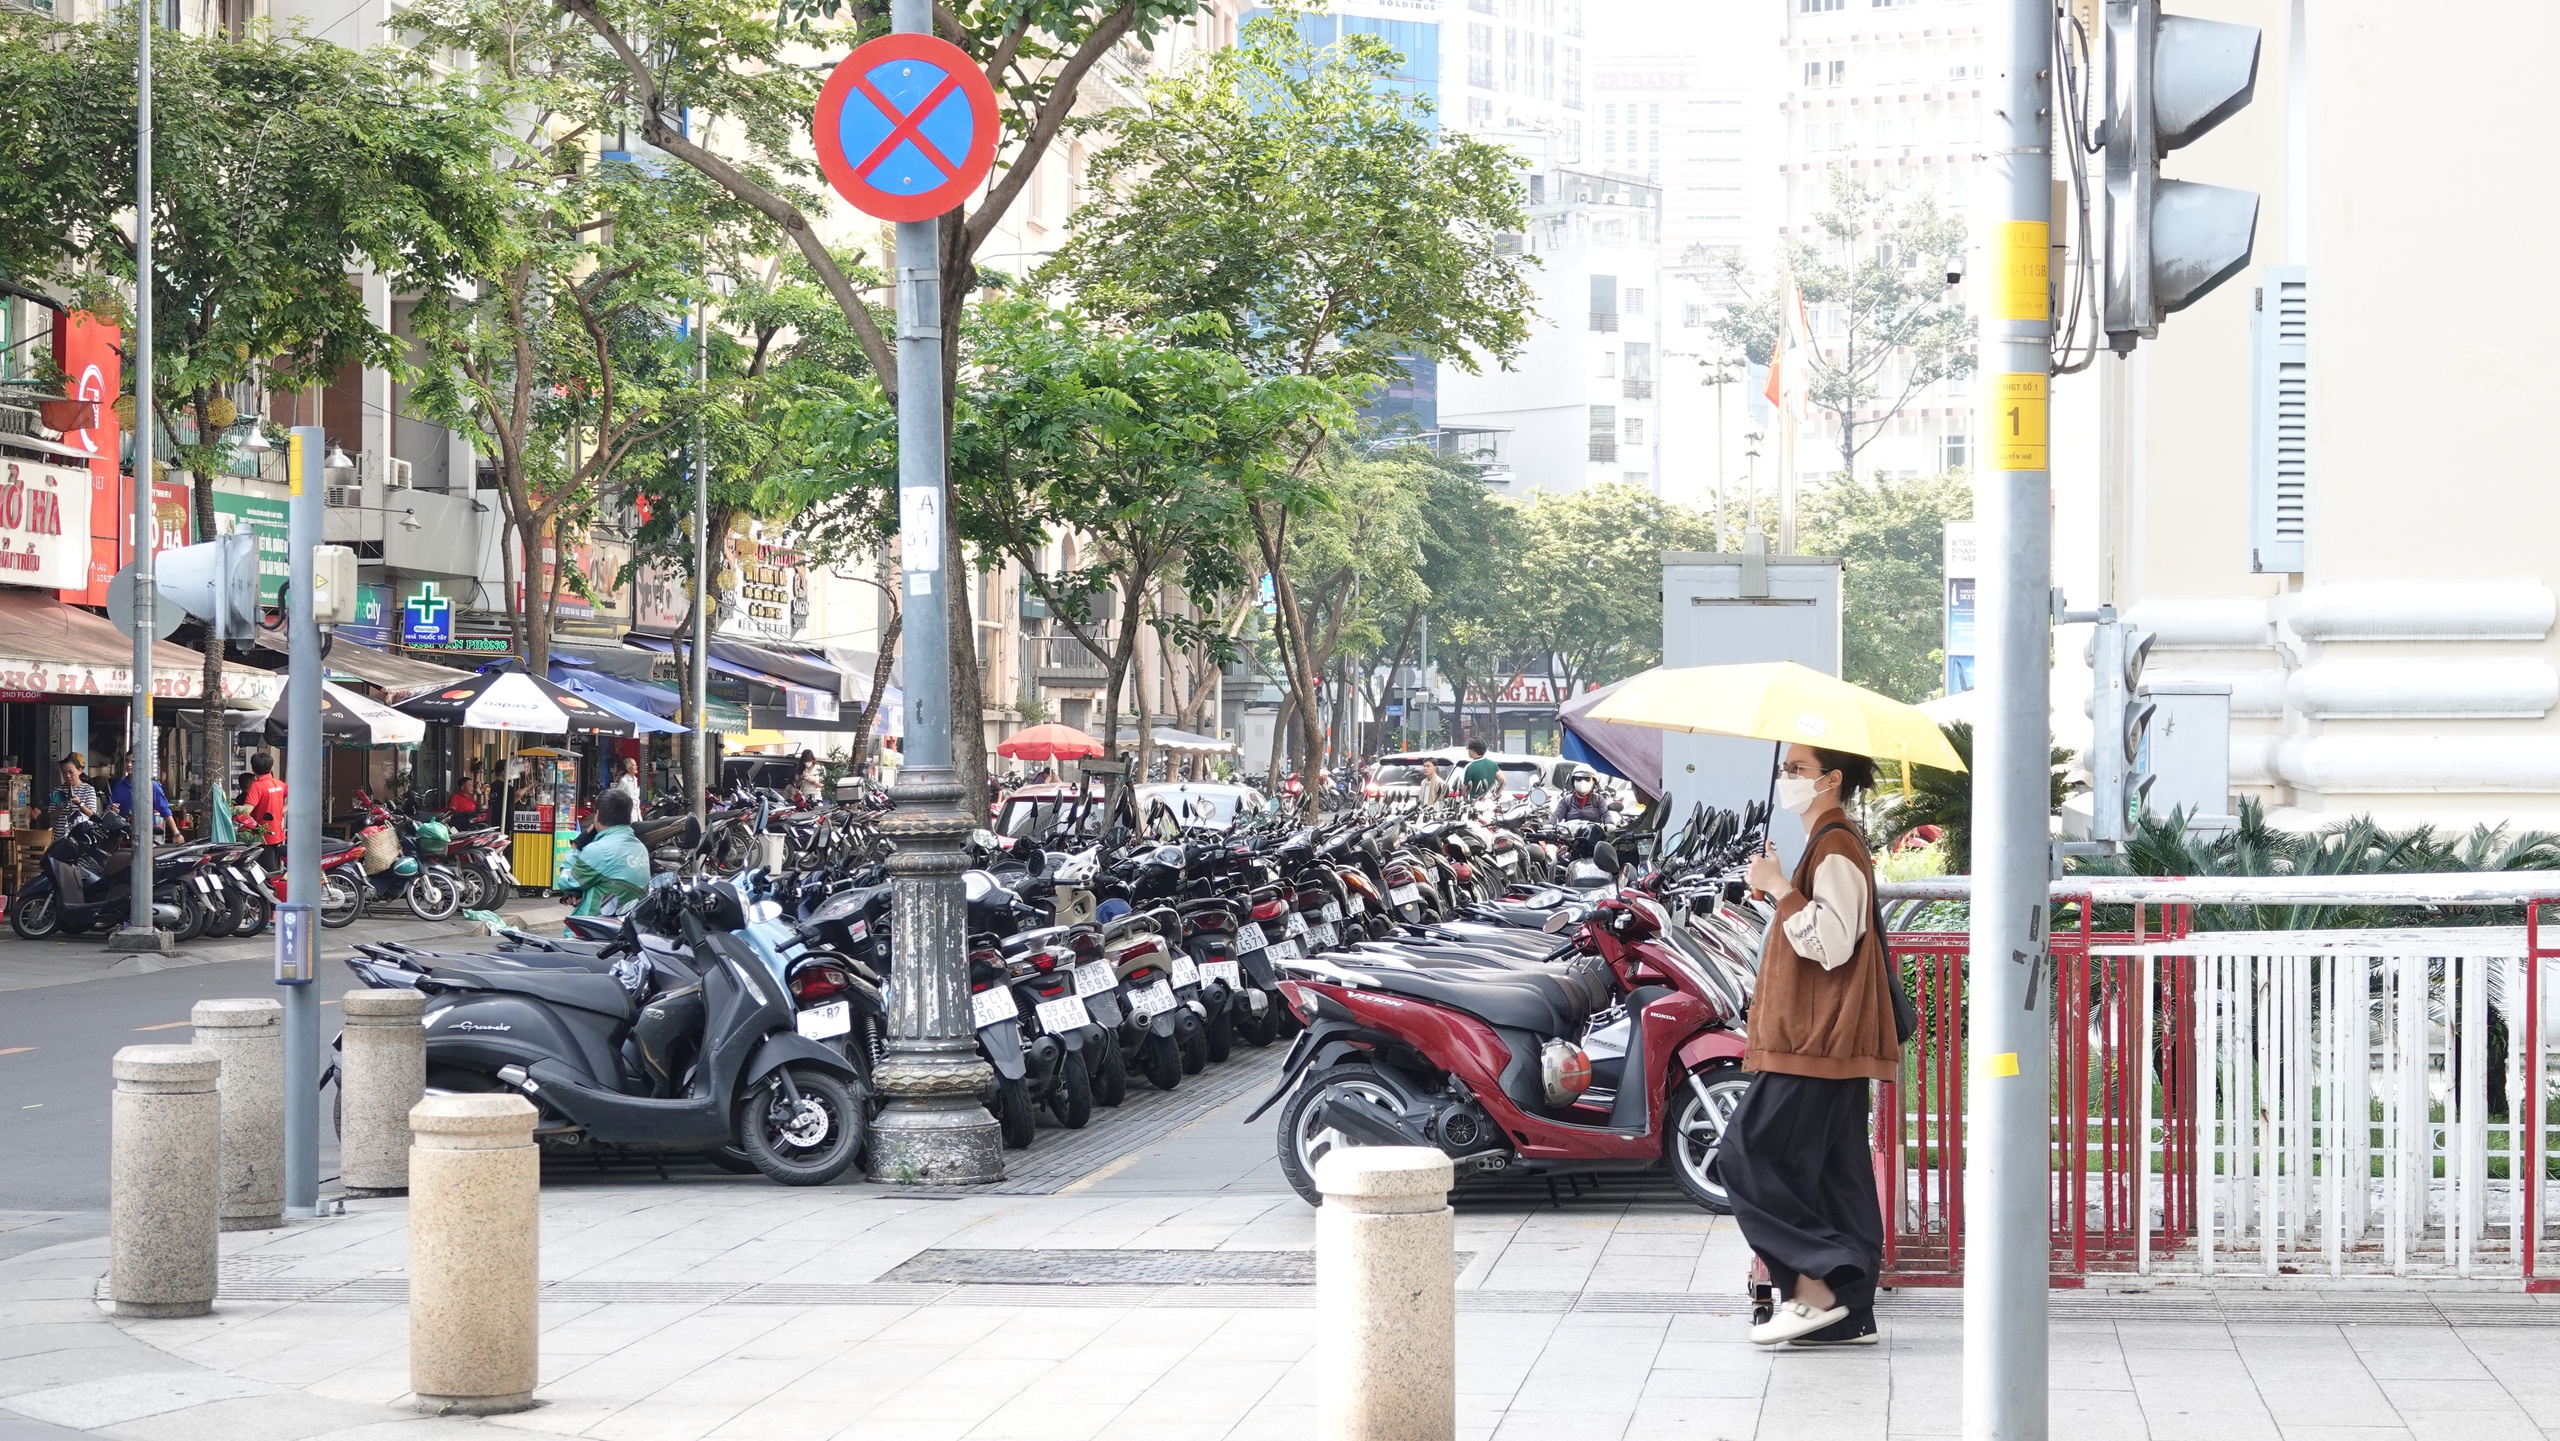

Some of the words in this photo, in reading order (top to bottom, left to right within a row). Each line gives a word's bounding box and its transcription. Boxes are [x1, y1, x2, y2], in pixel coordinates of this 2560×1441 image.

[2002, 383, 2020, 391] THGT
[2022, 381, 2032, 391] SỐ
[2007, 407, 2020, 436] 1
[0, 463, 24, 530] Ở
[26, 474, 62, 535] HÀ
[418, 632, 436, 641] THUỐC
[465, 638, 508, 651] PHÒNG
[56, 669, 100, 694] HÀ
[111, 670, 127, 681] 19
[1525, 681, 1550, 702] HÀ
[1075, 964, 1105, 981] 79-H5
[1206, 964, 1232, 976] 62-F1
[1081, 975, 1111, 995] 5696
[1139, 996, 1173, 1014] 90.33
[1347, 990, 1403, 1007] VISION
[1044, 999, 1077, 1018] 59-CA
[1650, 1011, 1676, 1020] HONDA
[448, 1020, 512, 1033] Grande
